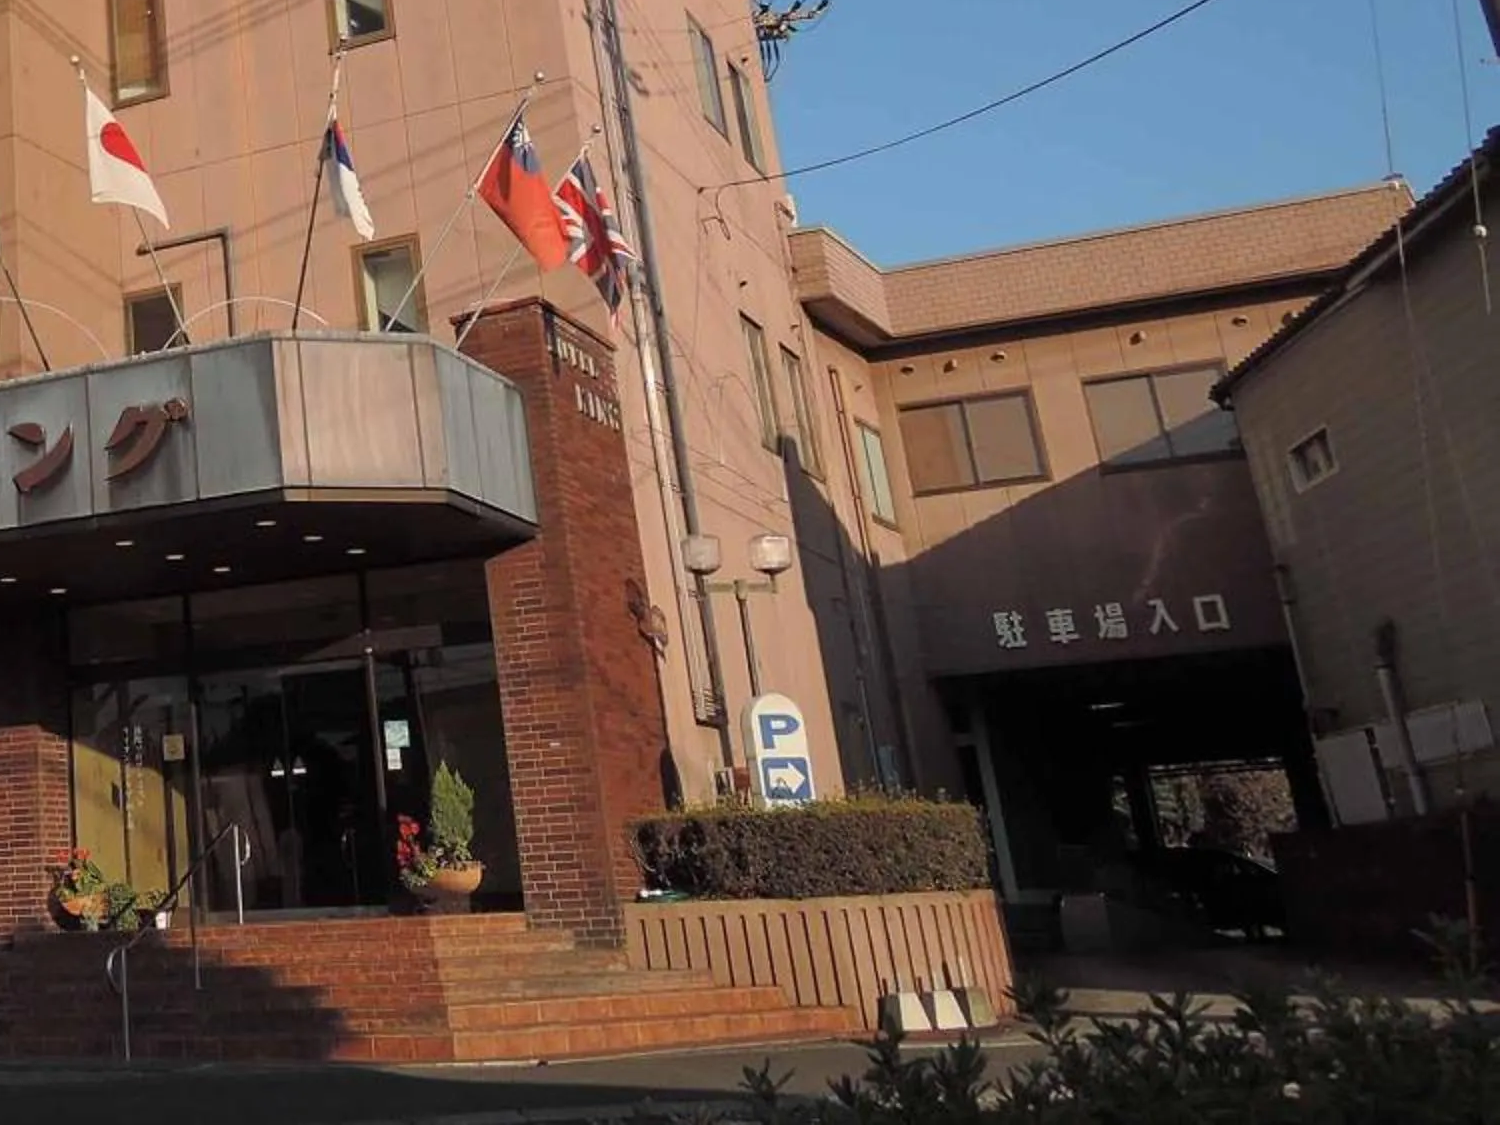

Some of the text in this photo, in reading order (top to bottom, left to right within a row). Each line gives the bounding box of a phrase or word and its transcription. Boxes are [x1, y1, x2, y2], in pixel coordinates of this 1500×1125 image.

[993, 594, 1230, 648] 駐車場入口
[758, 713, 801, 750] P
